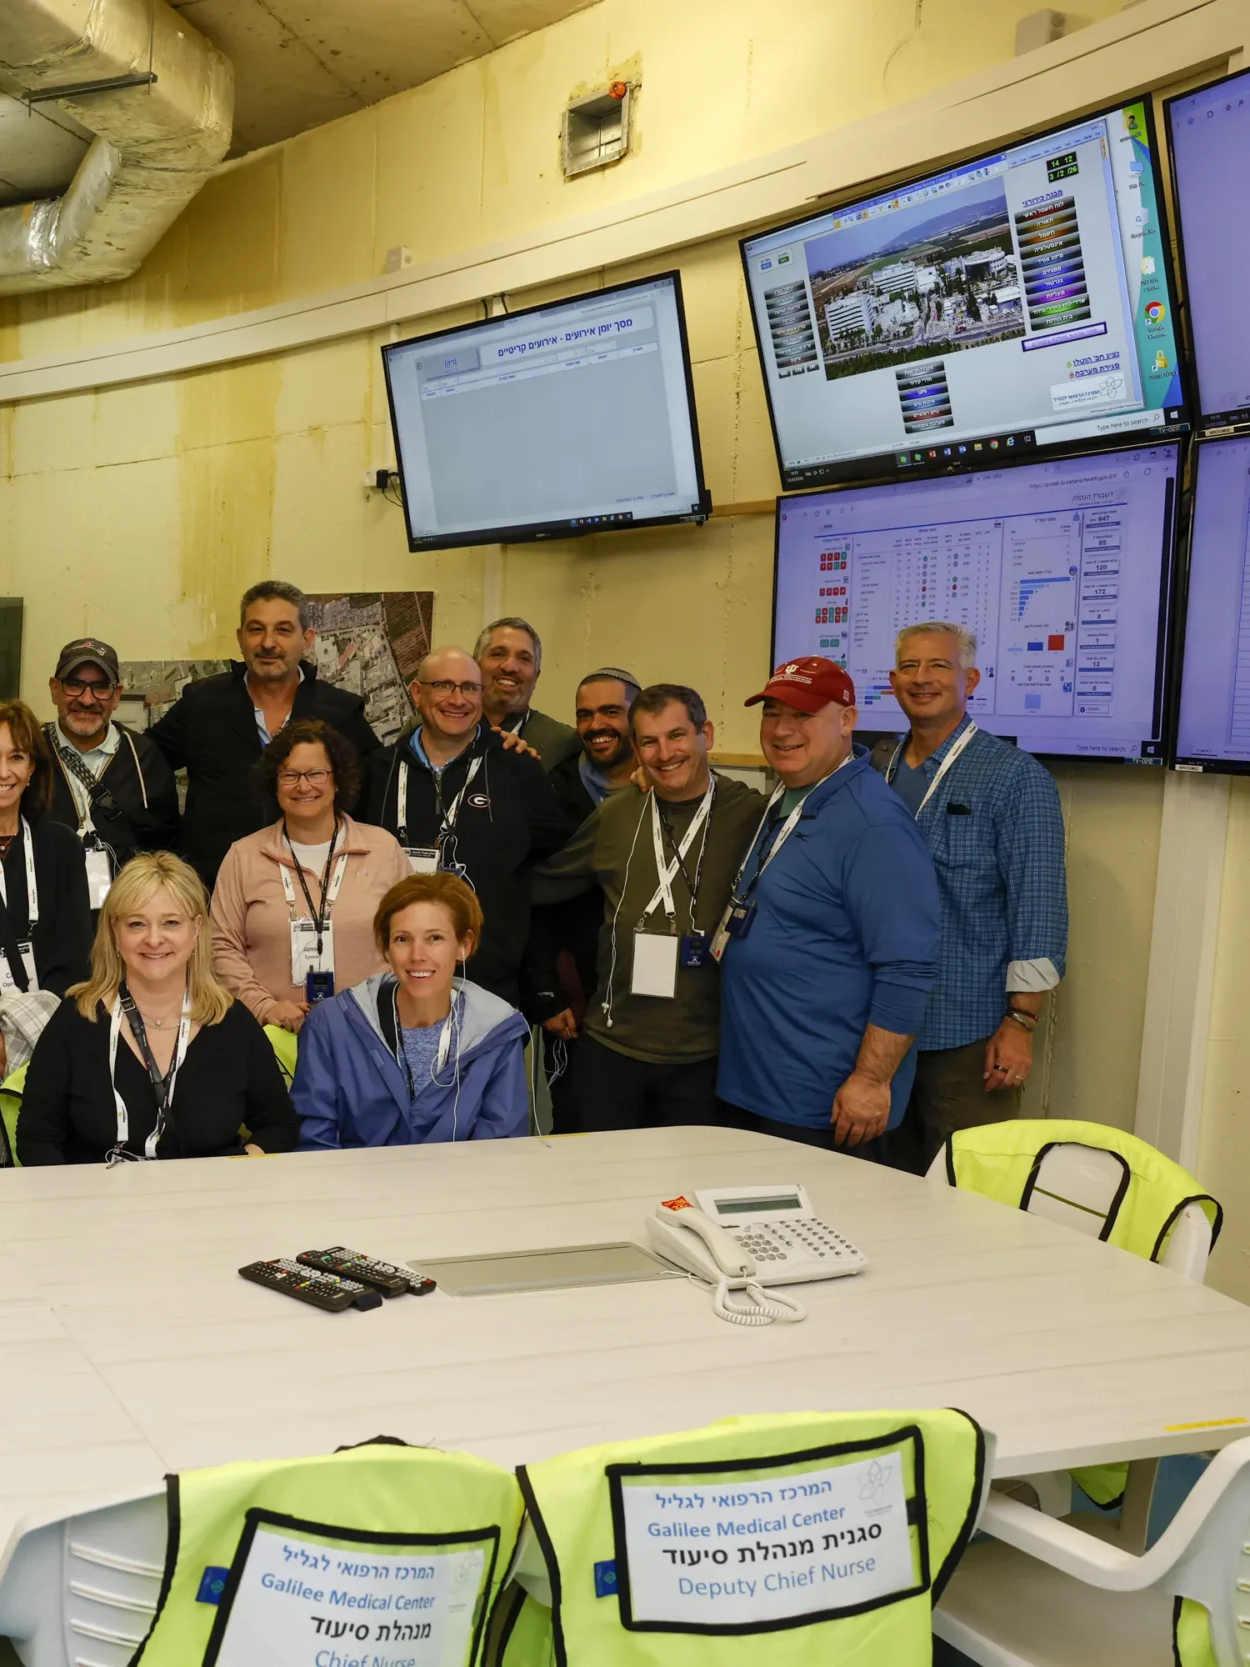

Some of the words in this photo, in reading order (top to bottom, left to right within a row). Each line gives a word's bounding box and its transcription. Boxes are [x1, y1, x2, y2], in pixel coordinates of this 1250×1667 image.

[1064, 155, 1073, 163] 12
[597, 323, 612, 336] יומן
[614, 317, 633, 331] מסך
[528, 335, 558, 350] אירועים
[565, 326, 596, 342] אירועים
[498, 342, 527, 358] קריטיים
[1131, 417, 1149, 426] search
[712, 1490, 773, 1507] הרפואי
[780, 1480, 832, 1501] המרכז
[655, 1493, 705, 1509] לגליל
[648, 1522, 711, 1538] Galilee
[717, 1515, 787, 1537] Medical
[792, 1505, 846, 1528] Center
[822, 1522, 882, 1551] סגנית
[282, 1545, 331, 1572] לגליל
[663, 1548, 728, 1566] סיעוד
[737, 1537, 814, 1564] מנהלת
[337, 1560, 390, 1580] הרפואי
[395, 1566, 435, 1580] המרכז
[678, 1577, 757, 1601] Deputy
[764, 1565, 815, 1592] Chief
[821, 1555, 876, 1581] Nurse
[261, 1572, 324, 1602] Galilee
[329, 1589, 391, 1611] Medical
[395, 1594, 435, 1611] Center
[310, 1616, 369, 1641] סיעוד
[375, 1620, 432, 1642] מנהלת
[315, 1649, 369, 1667] Chief
[372, 1656, 416, 1667] Nurse
